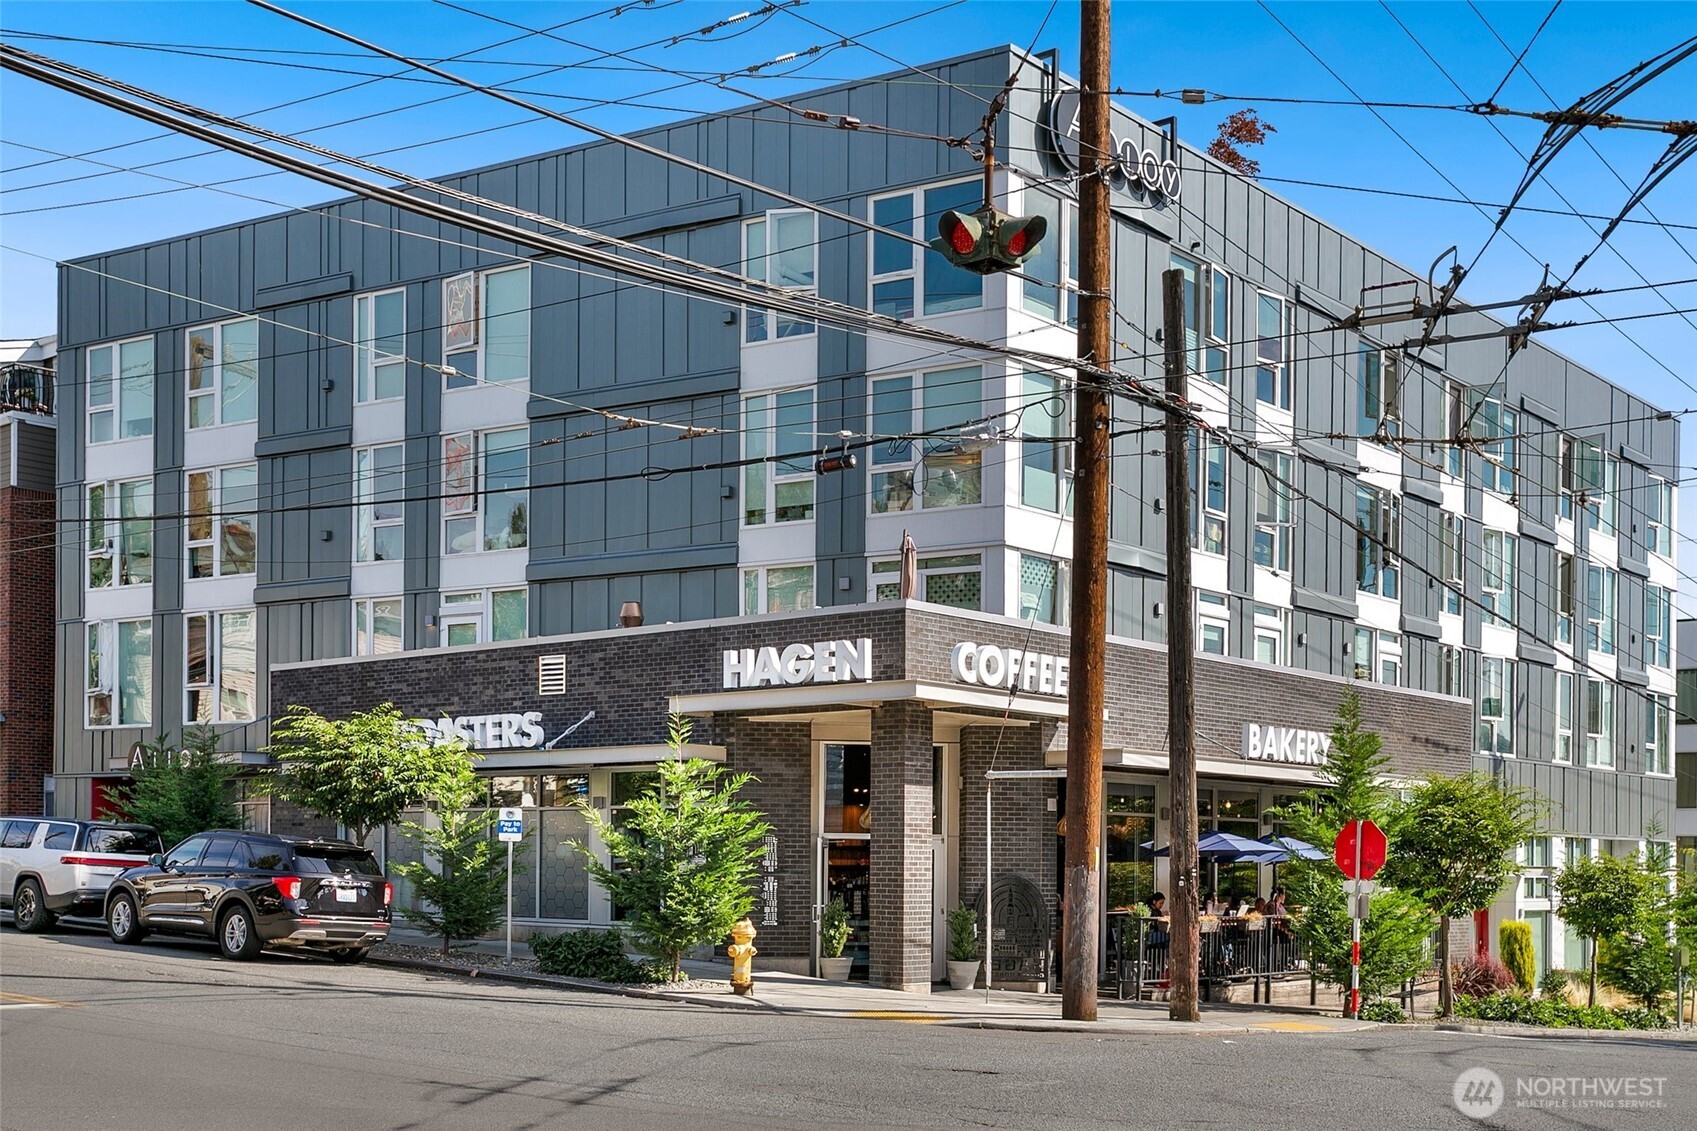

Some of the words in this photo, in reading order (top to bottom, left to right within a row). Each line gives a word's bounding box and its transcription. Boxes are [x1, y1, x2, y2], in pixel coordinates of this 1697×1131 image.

[723, 638, 872, 689] HAGEN
[951, 642, 1069, 695] COFFEE
[397, 712, 545, 750] OASTERS
[1243, 723, 1333, 765] BAKERY
